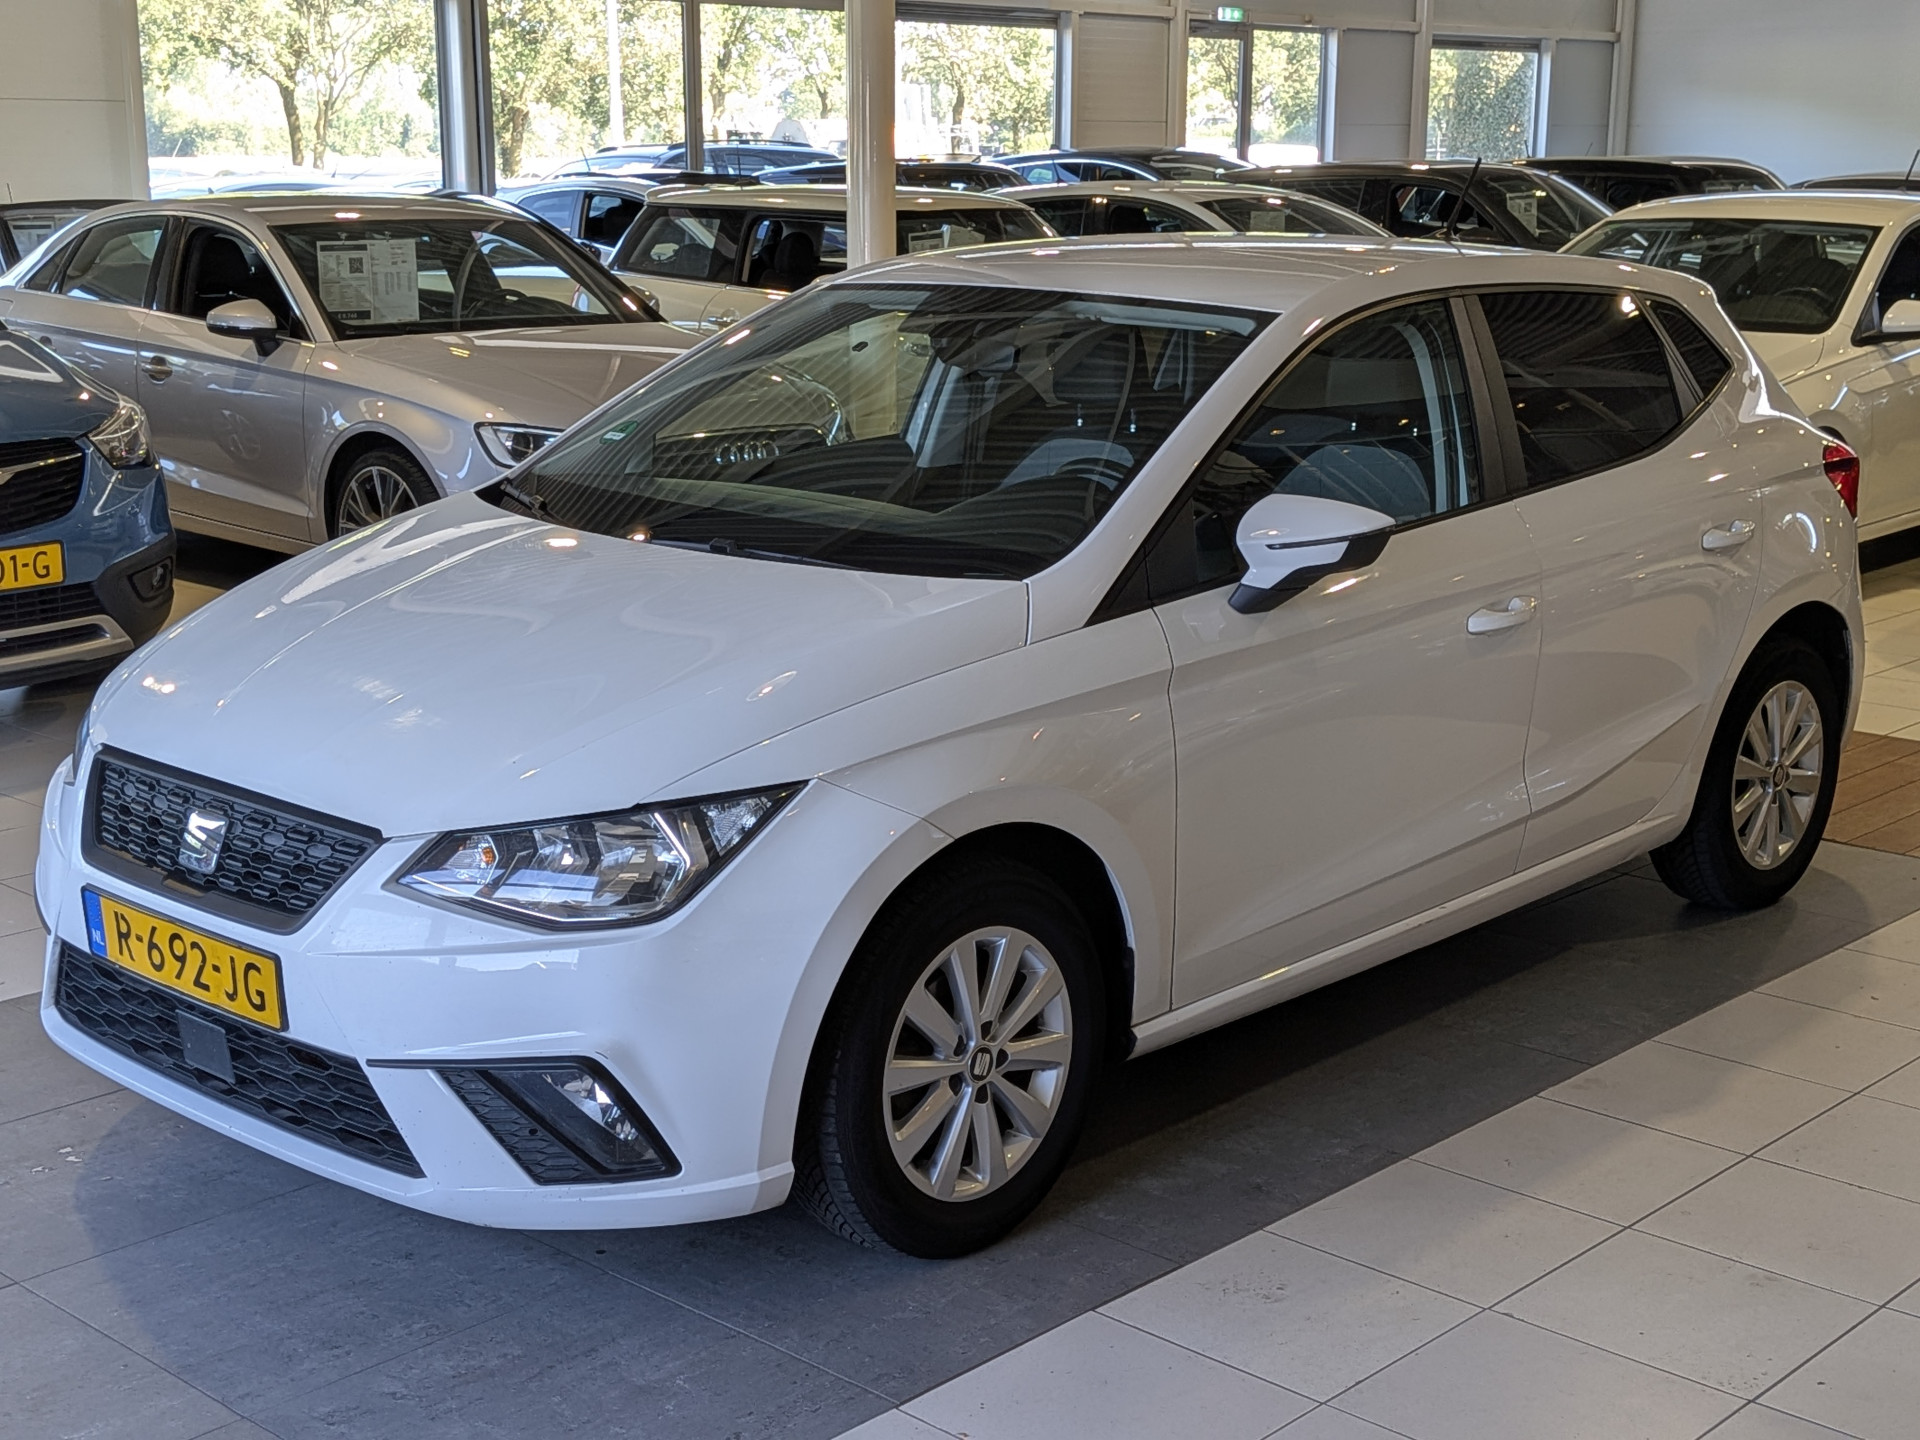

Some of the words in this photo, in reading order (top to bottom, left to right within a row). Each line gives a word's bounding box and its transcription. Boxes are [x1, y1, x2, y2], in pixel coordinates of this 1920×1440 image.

[0, 551, 50, 584] 1-G
[92, 928, 105, 945] NL
[113, 910, 267, 1012] R-692-JG
